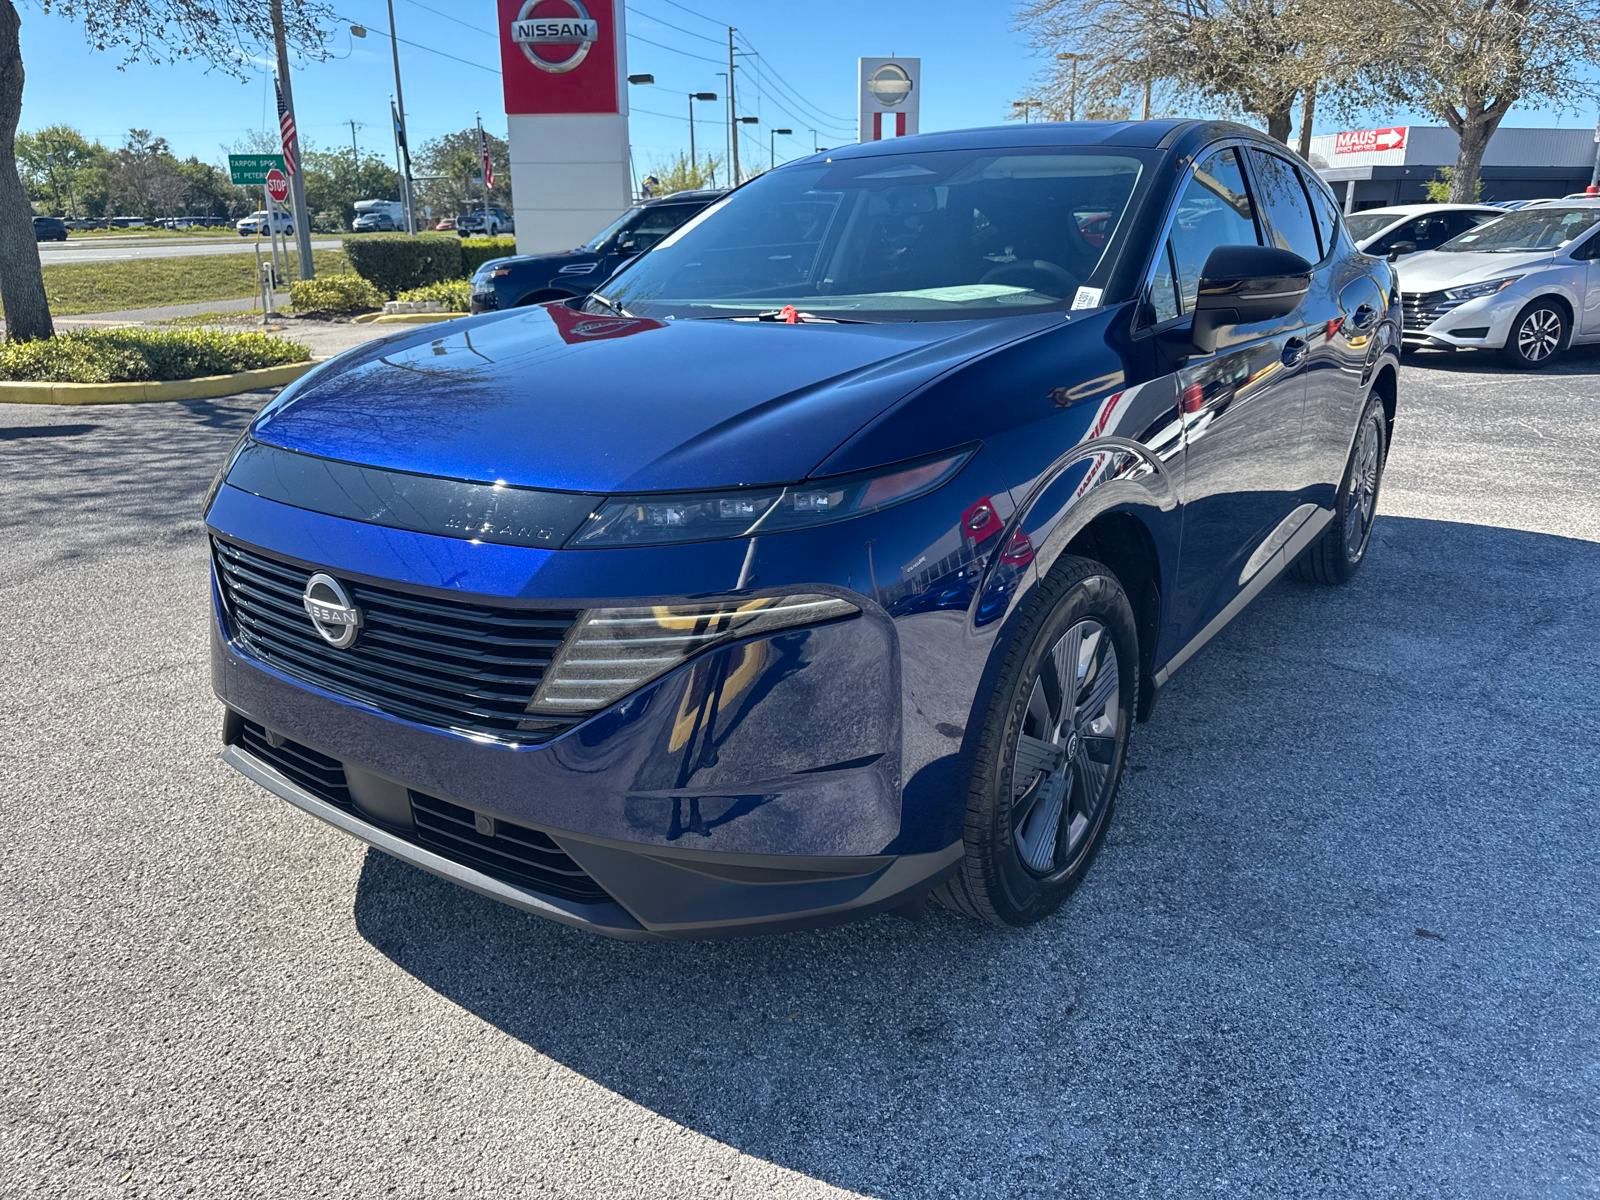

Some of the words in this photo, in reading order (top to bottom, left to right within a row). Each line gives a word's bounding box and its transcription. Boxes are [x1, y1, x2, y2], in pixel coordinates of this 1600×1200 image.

[518, 23, 588, 38] NISSAN
[1337, 131, 1377, 146] MAUS
[268, 179, 286, 192] STOP
[445, 519, 554, 539] MURANO
[304, 602, 355, 623] NISSAN
